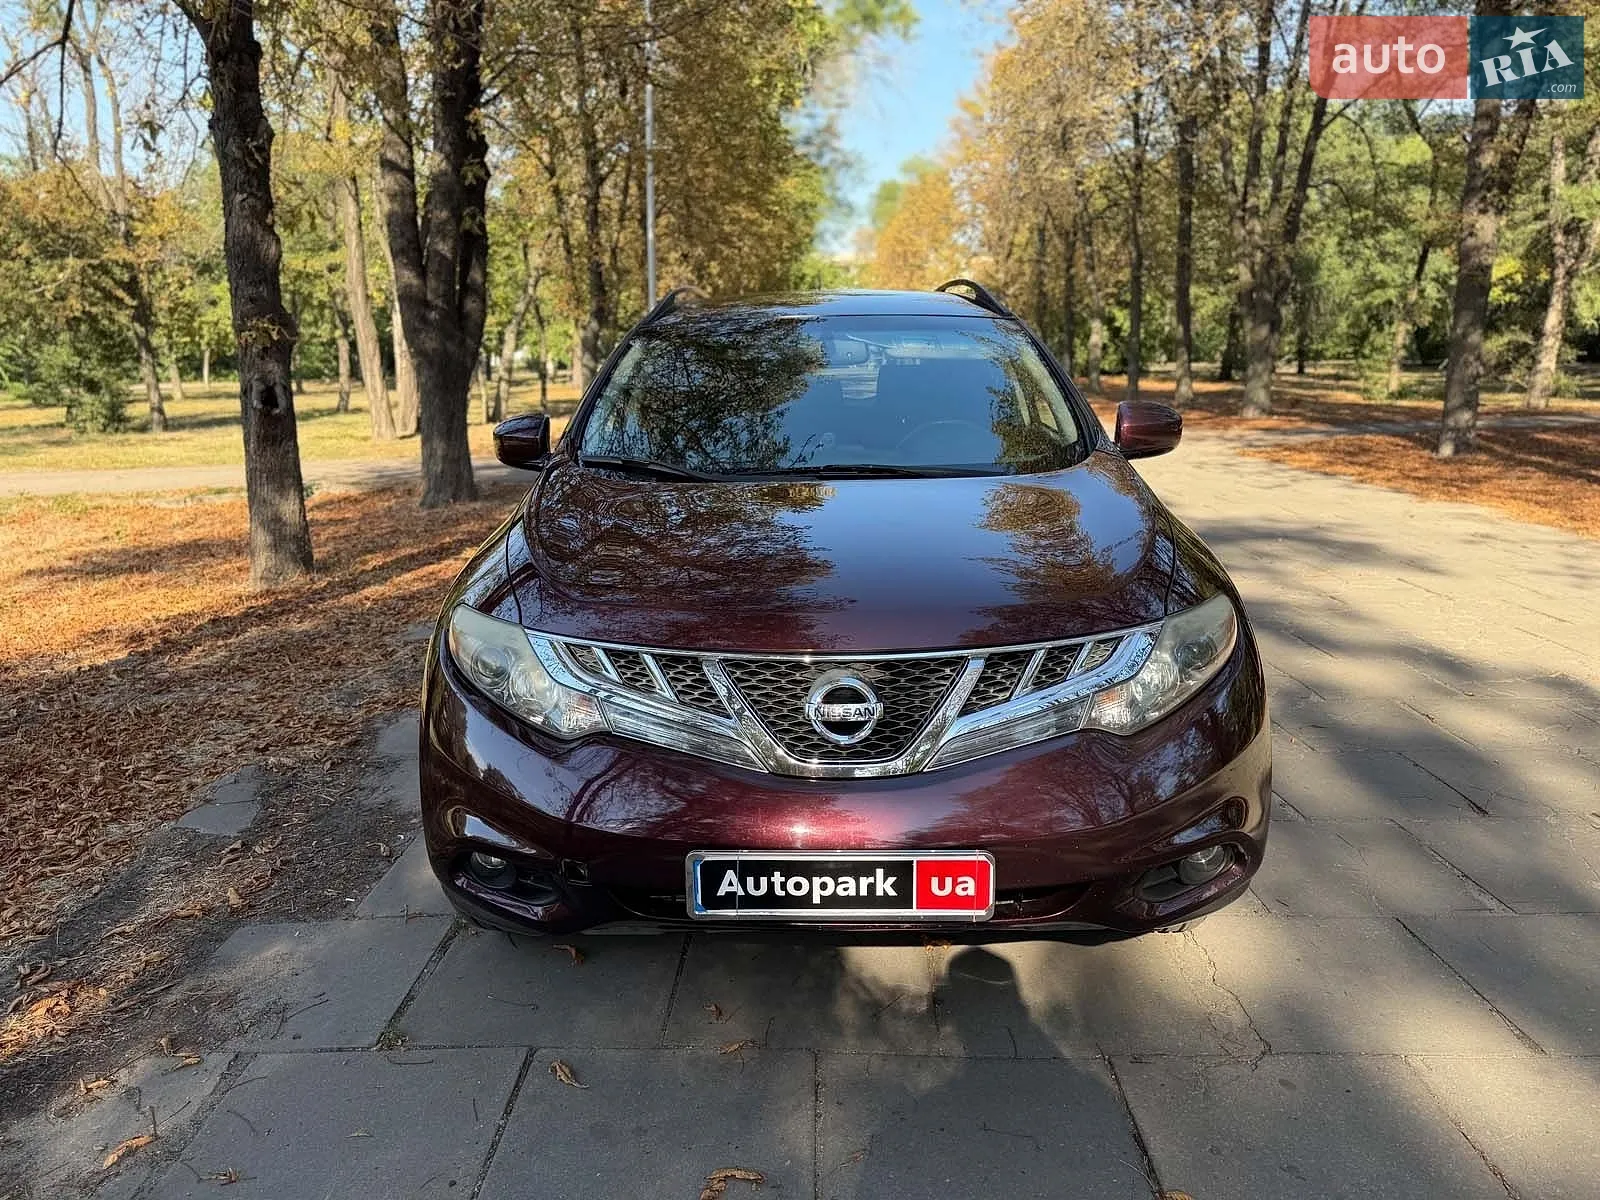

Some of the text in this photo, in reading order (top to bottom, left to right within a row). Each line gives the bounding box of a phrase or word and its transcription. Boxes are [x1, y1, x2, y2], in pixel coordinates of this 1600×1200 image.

[813, 706, 876, 718] NISSAN
[717, 869, 976, 904] Autopark ua
